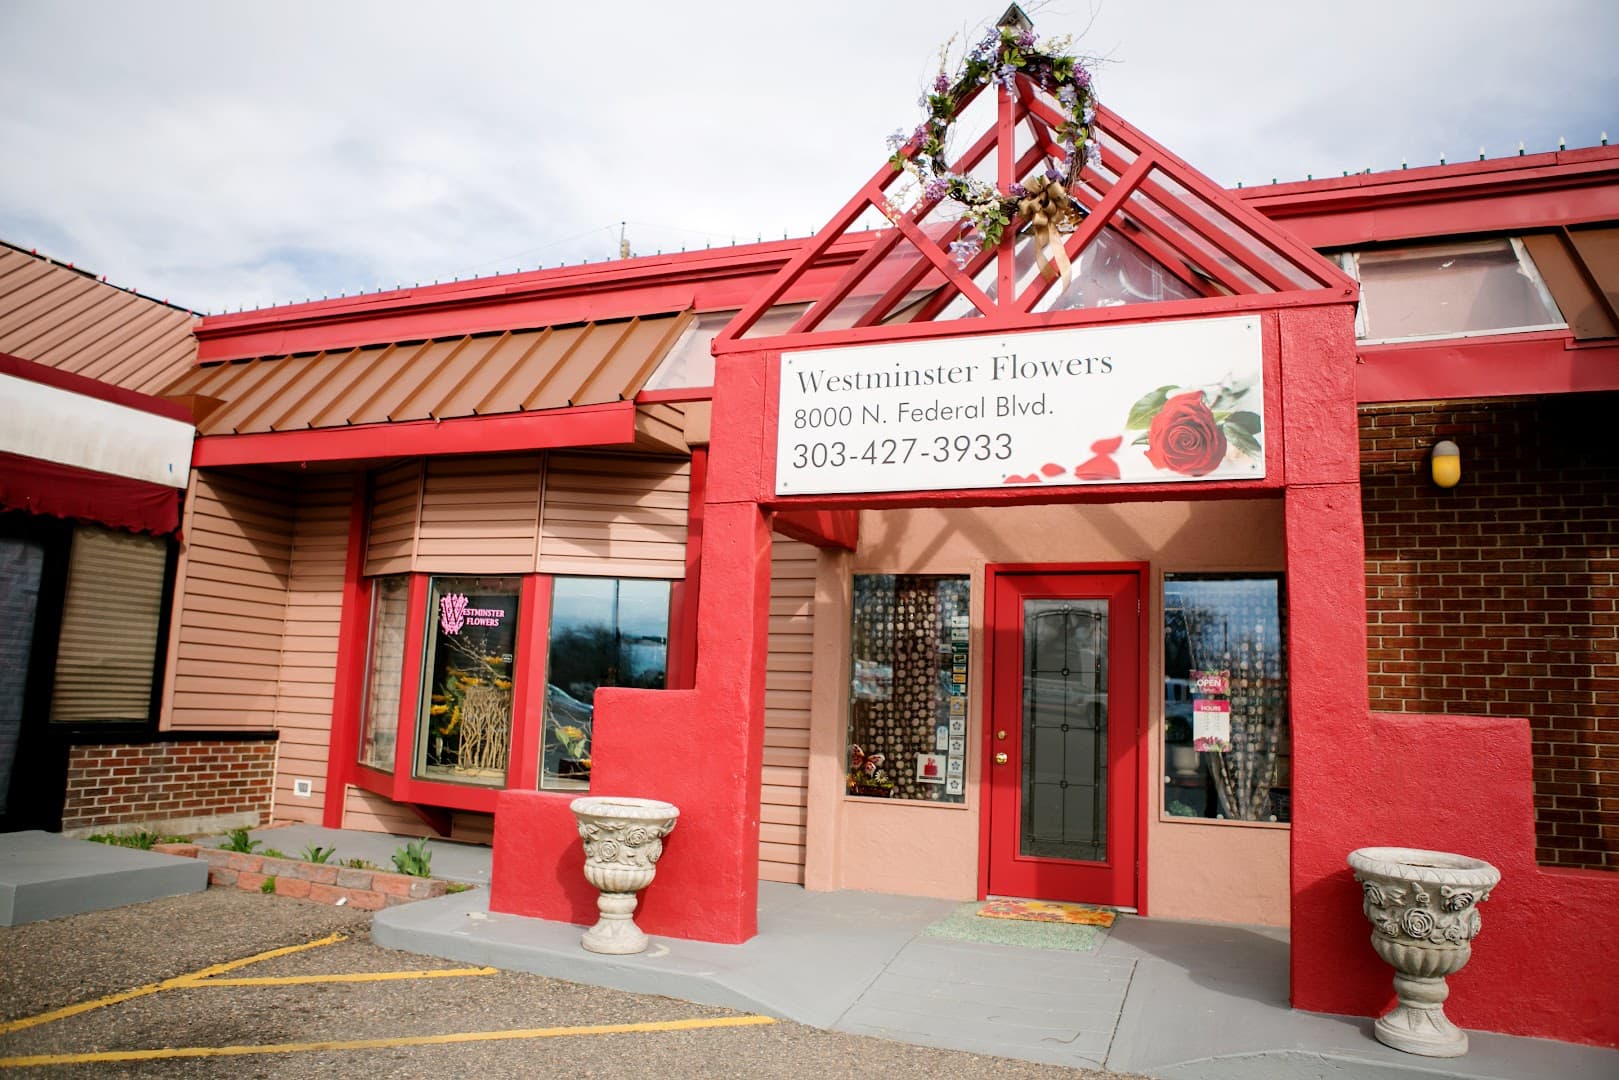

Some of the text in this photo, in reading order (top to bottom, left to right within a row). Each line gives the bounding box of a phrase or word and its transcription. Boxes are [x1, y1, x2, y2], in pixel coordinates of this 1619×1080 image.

[797, 352, 1113, 394] Westminster Flowers
[794, 393, 1054, 429] 8000 N. Federal Blvd.
[792, 433, 1013, 469] 303-427-3933
[466, 617, 500, 627] FLOWERS
[1197, 678, 1221, 687] OPEN
